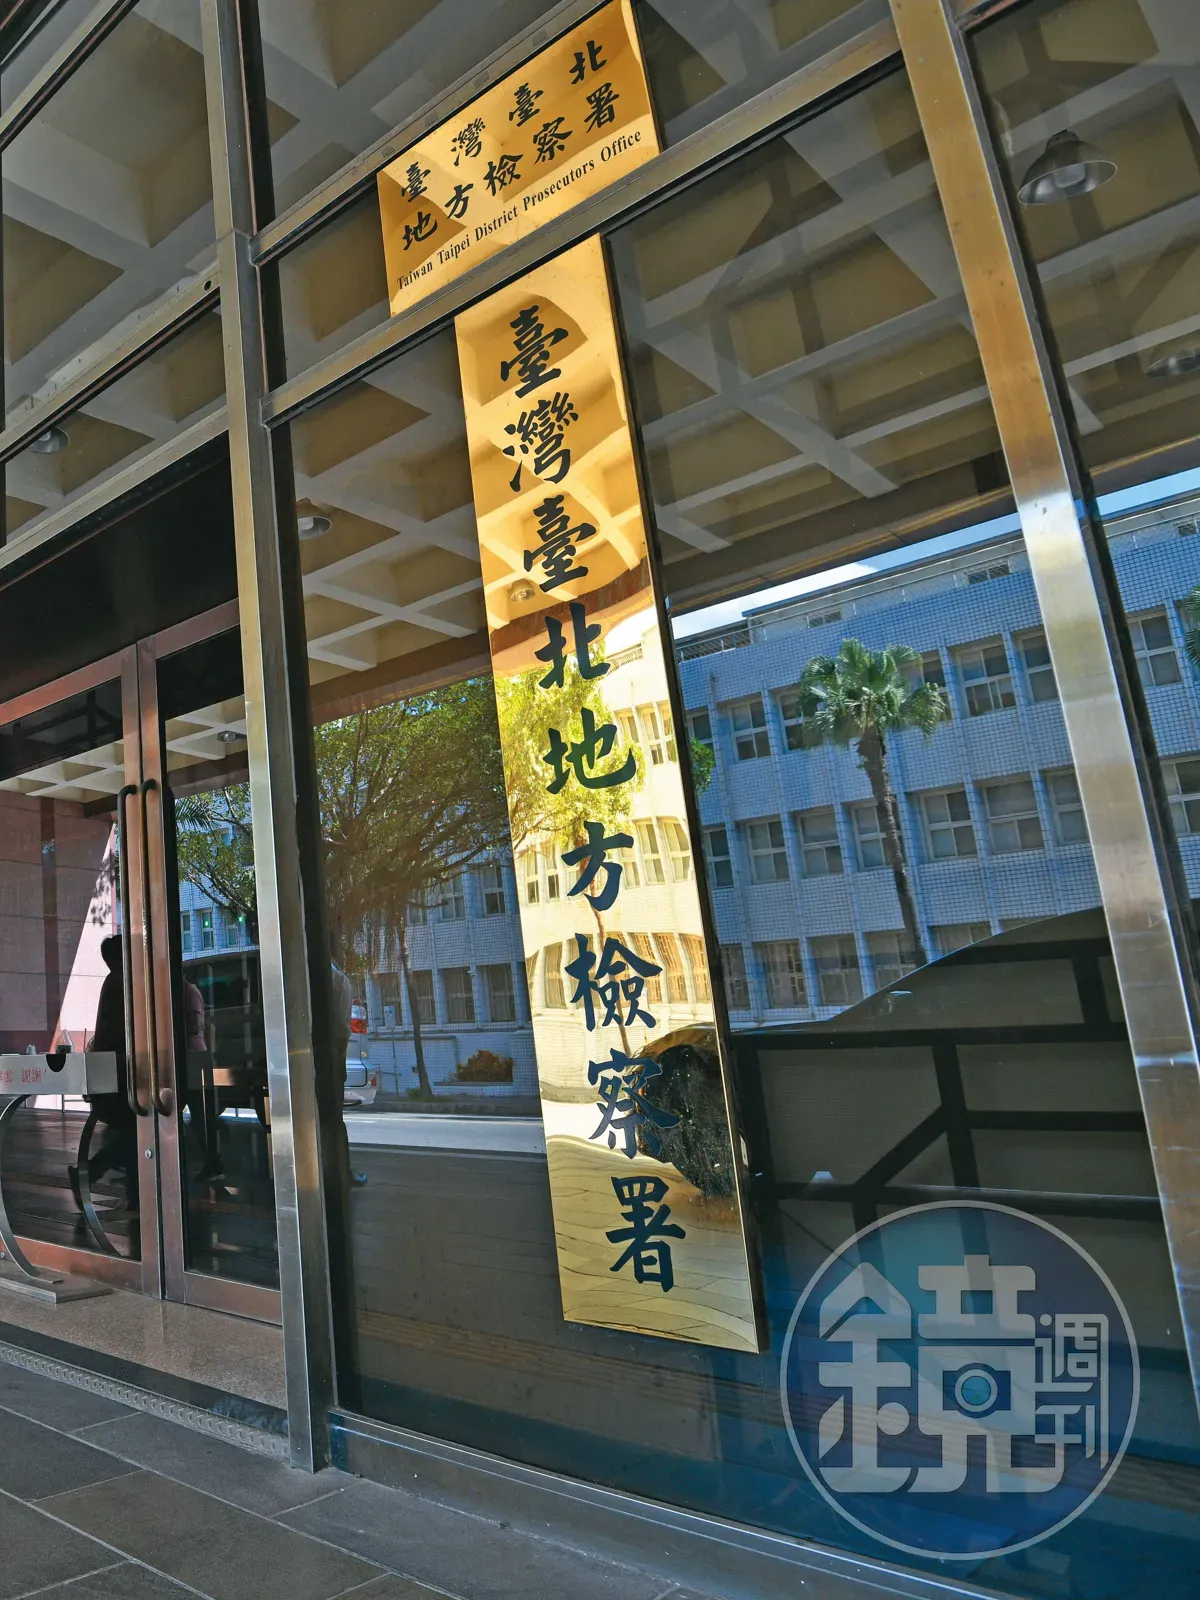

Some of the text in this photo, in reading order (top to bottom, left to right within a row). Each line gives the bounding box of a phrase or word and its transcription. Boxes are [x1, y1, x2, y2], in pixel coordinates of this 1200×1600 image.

[401, 40, 607, 203] 臺灣臺北
[402, 82, 620, 250] 地方檢察署
[397, 131, 641, 290] Taiwan Taipei District Prosecutors Office
[500, 305, 686, 1293] 臺灣臺北地方檢察署
